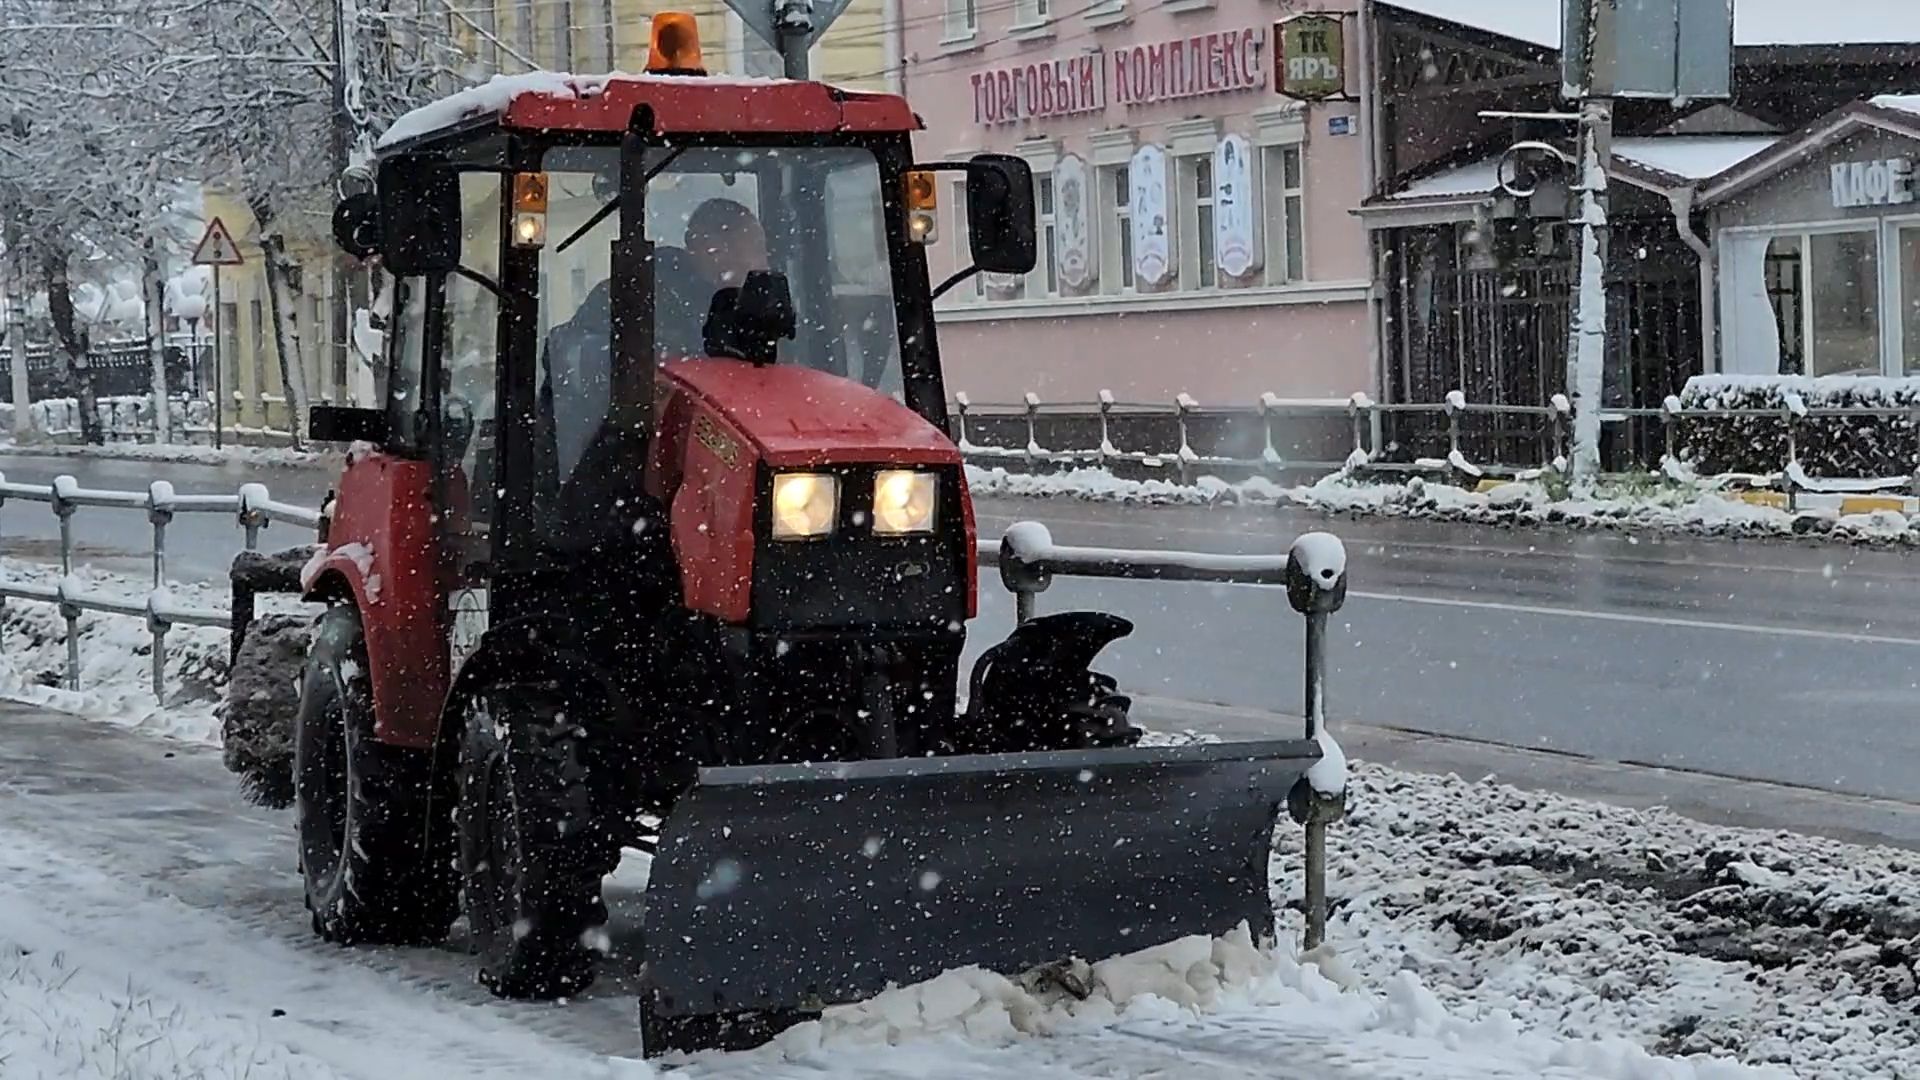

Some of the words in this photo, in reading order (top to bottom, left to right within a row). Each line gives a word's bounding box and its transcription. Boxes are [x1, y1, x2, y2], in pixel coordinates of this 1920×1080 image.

[1298, 30, 1328, 53] ТК
[1114, 28, 1255, 102] КОМПЛЕКС
[1289, 56, 1338, 80] ЯРЪ
[1831, 158, 1913, 207] КАФЕ
